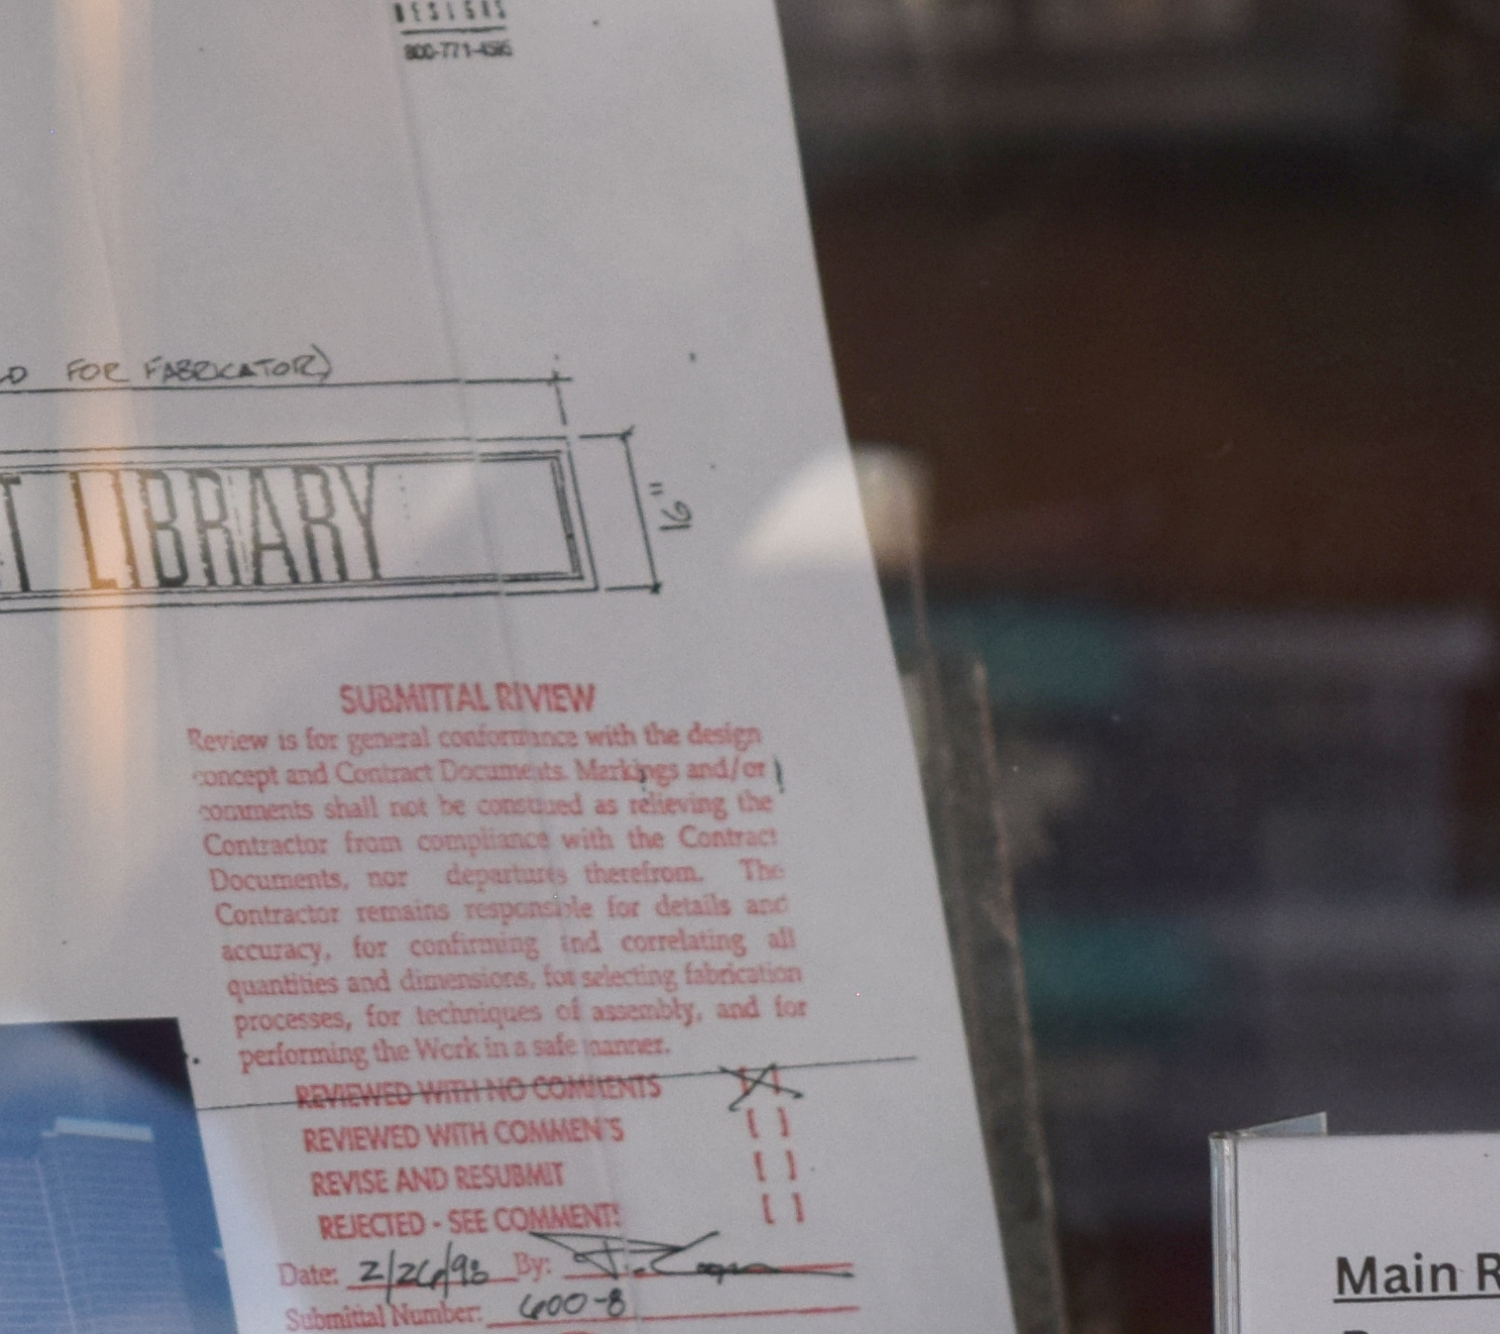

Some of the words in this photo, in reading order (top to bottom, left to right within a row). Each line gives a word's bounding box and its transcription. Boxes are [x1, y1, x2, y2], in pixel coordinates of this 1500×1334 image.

[66, 356, 130, 383] FOR
[66, 464, 383, 592] LIBRARY
[339, 681, 490, 714] SUBMITTAL
[303, 1125, 421, 1154] REVIEWED
[426, 1121, 488, 1149] WITH
[311, 1168, 390, 1197] REVISE
[395, 1166, 449, 1193] AND
[456, 1161, 565, 1191] RESUBMIT
[317, 1212, 425, 1241] REJECTED
[448, 1207, 489, 1235] SEE
[279, 1262, 340, 1289] Date:
[513, 1252, 552, 1279] By:
[1334, 1252, 1460, 1297] Main
[284, 1305, 388, 1333] Submittal
[391, 1301, 483, 1327] Number:
